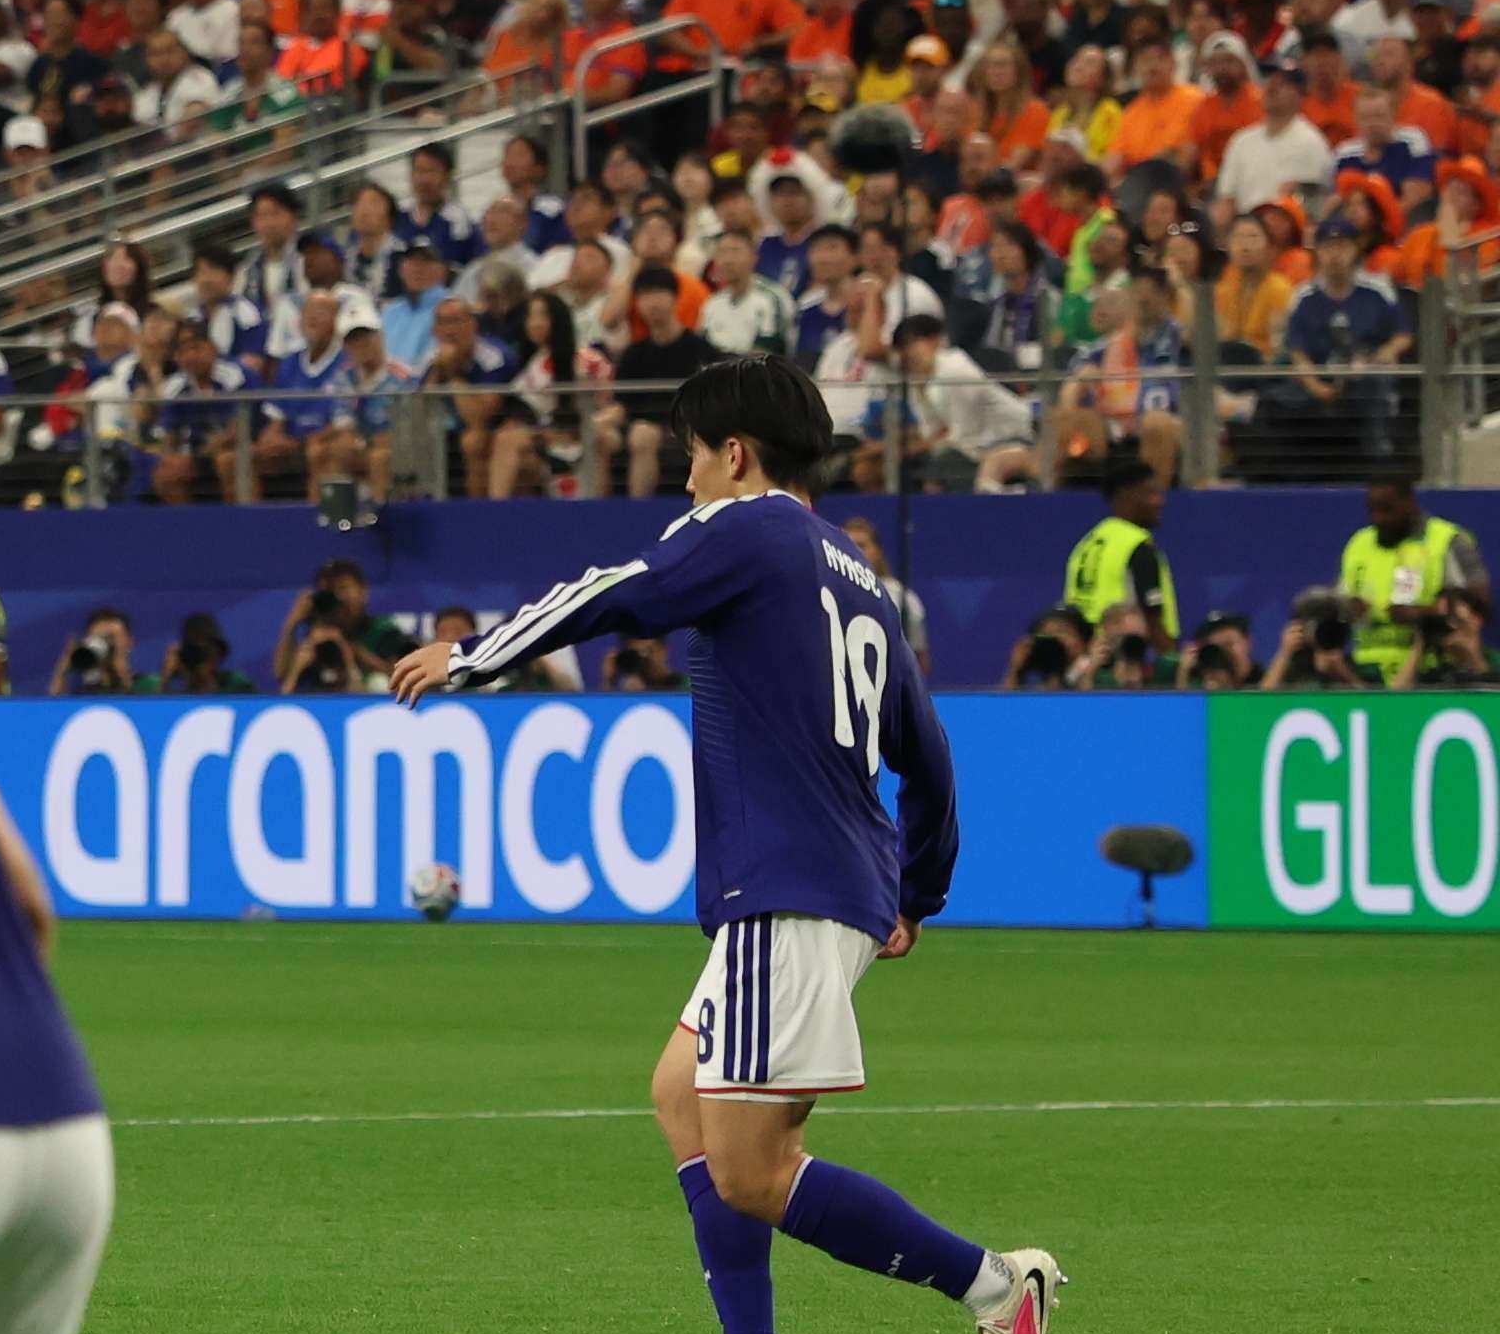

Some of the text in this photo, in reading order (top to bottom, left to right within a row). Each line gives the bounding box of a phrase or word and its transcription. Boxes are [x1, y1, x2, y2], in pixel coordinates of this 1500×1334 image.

[820, 537, 882, 599] AYASE
[42, 703, 696, 915] aramco
[1263, 709, 1498, 916] GLO
